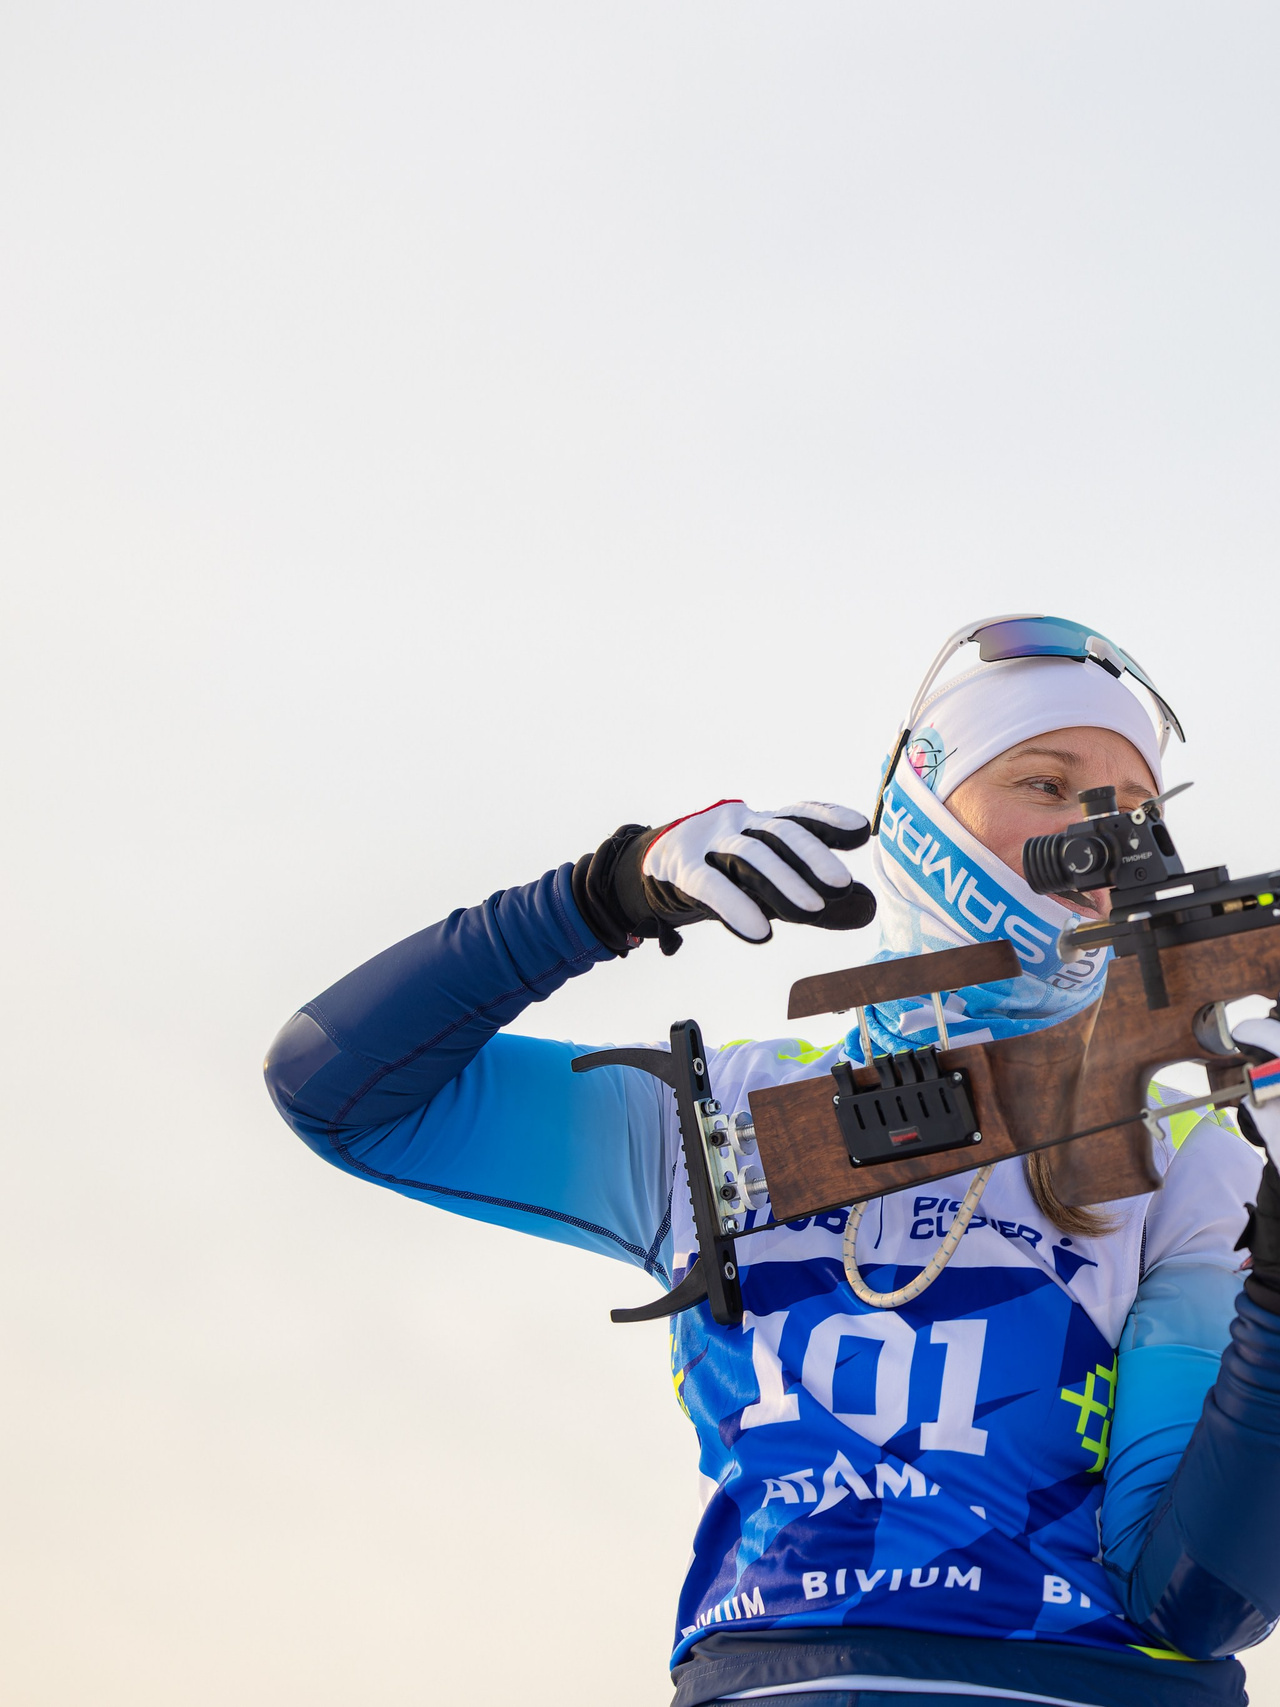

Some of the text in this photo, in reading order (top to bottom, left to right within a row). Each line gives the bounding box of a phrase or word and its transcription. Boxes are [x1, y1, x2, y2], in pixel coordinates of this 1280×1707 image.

[880, 786, 1053, 965] SAMAR
[1121, 851, 1153, 864] ПИОНЕР
[740, 1310, 989, 1457] 101
[802, 1565, 982, 1600] BIVIUM
